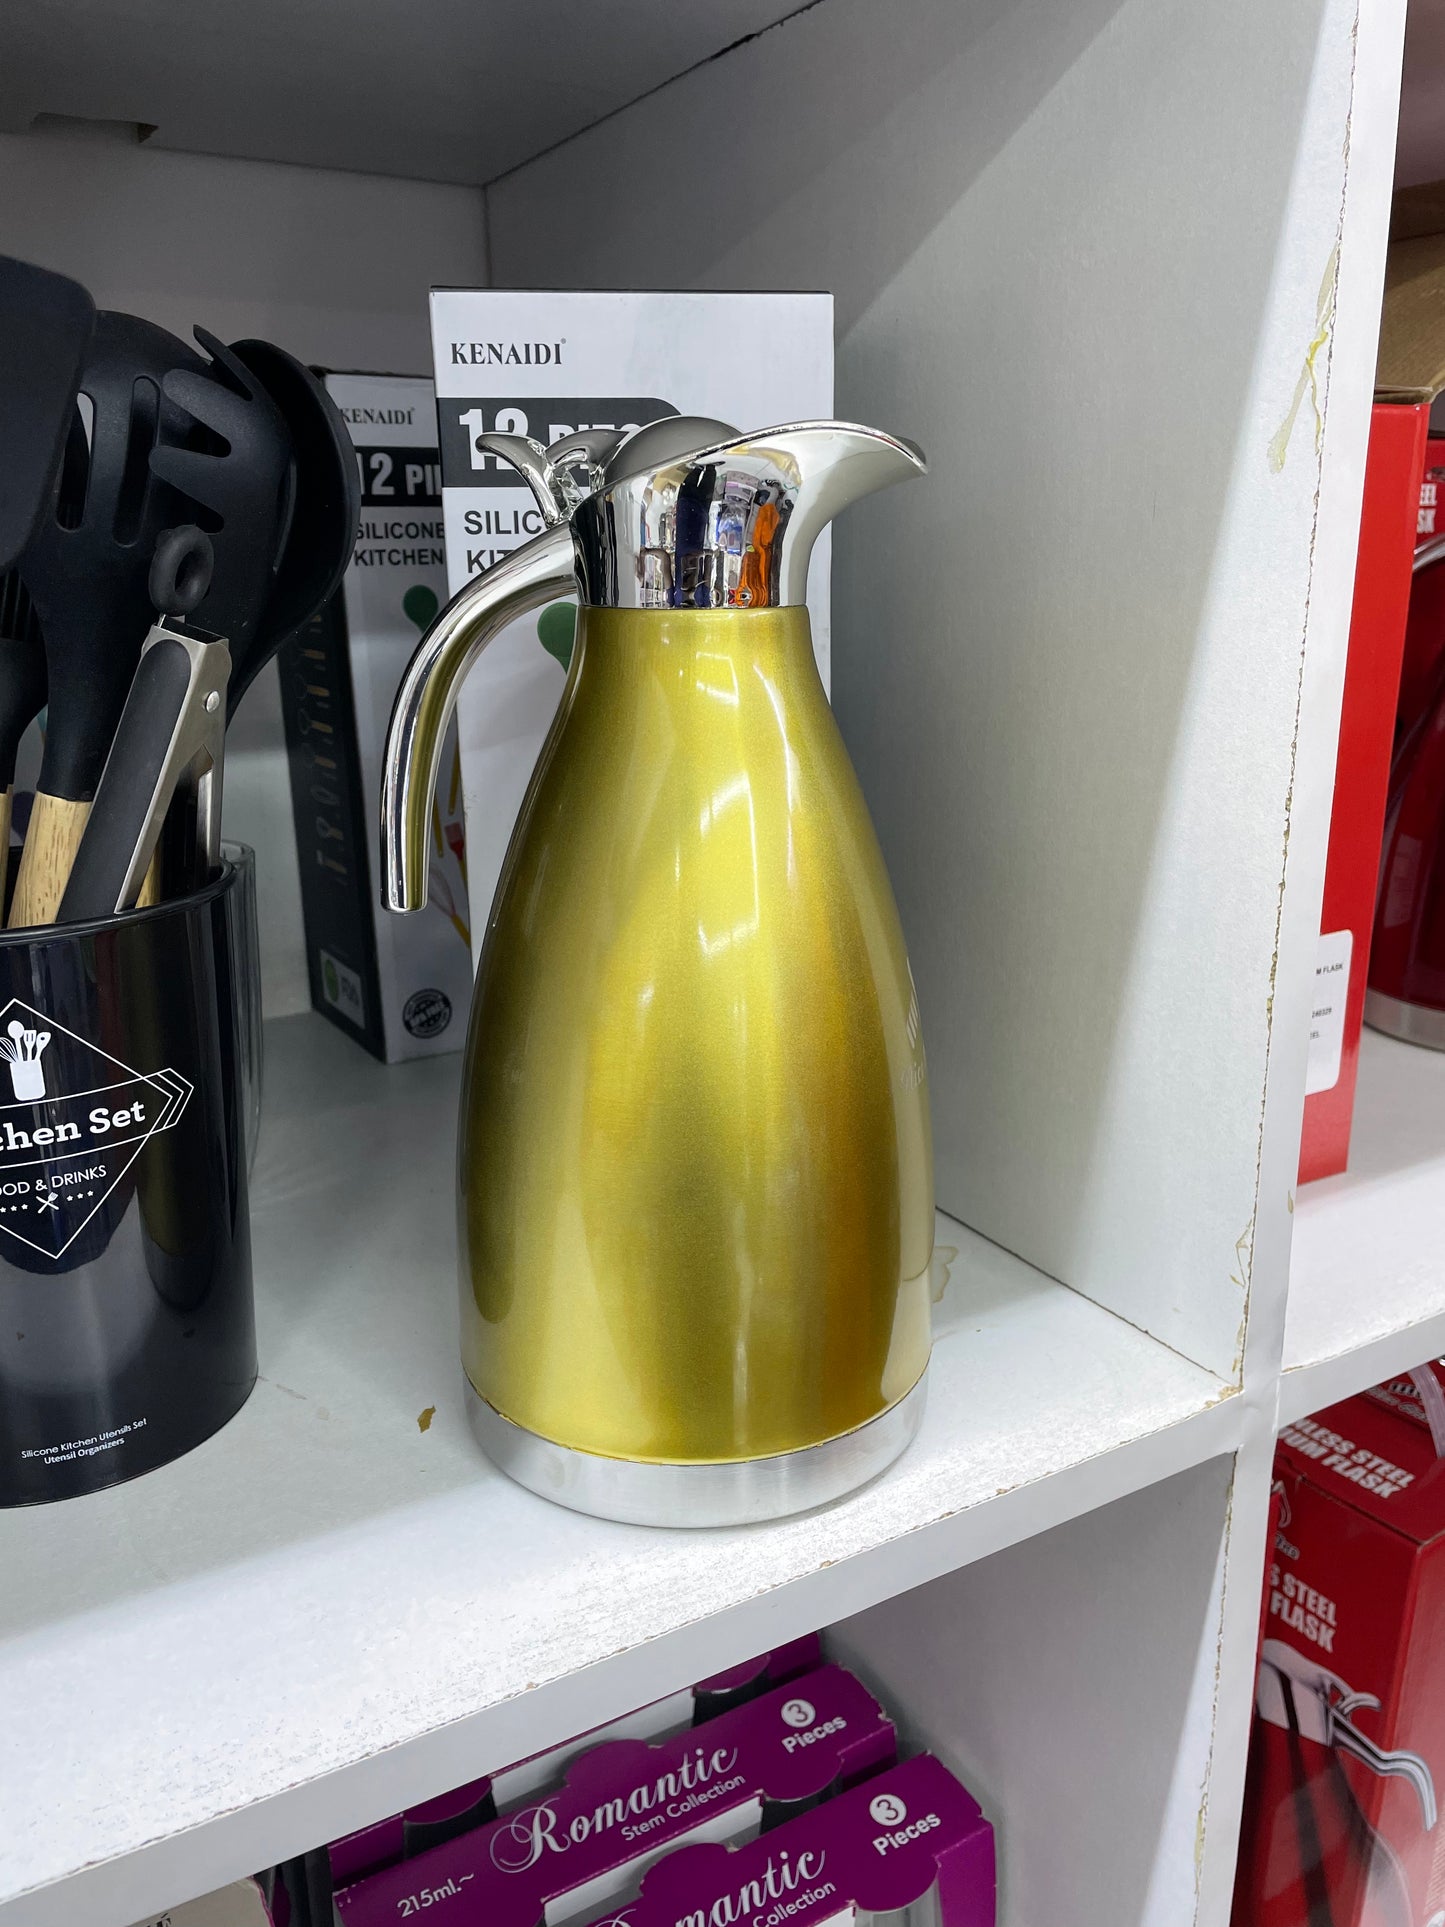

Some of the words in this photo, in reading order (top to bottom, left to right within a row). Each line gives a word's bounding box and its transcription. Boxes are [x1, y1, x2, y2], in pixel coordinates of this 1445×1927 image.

[451, 342, 563, 365] KENAIDI
[353, 549, 444, 566] KITCHEN
[89, 1101, 146, 1134] Set
[0, 1181, 31, 1196] OD
[35, 1179, 48, 1191] &
[51, 1165, 107, 1188] DRINKS
[21, 1446, 59, 1459] Silicone
[60, 1436, 98, 1451] Kitchen
[99, 1424, 132, 1441] Utensils
[132, 1417, 148, 1430] Set
[44, 1452, 77, 1465] Utensil
[77, 1437, 125, 1457] Organizers
[1321, 1453, 1401, 1499] FLASK
[1350, 1449, 1416, 1488] STEEL
[1282, 1572, 1337, 1627] STEEL
[1270, 1589, 1336, 1653] FLASK
[781, 1716, 847, 1754] Pieces
[490, 1747, 738, 1874] Romantic
[621, 1814, 666, 1841] Stem
[666, 1775, 746, 1818] Collection
[872, 1813, 942, 1856] Pieces
